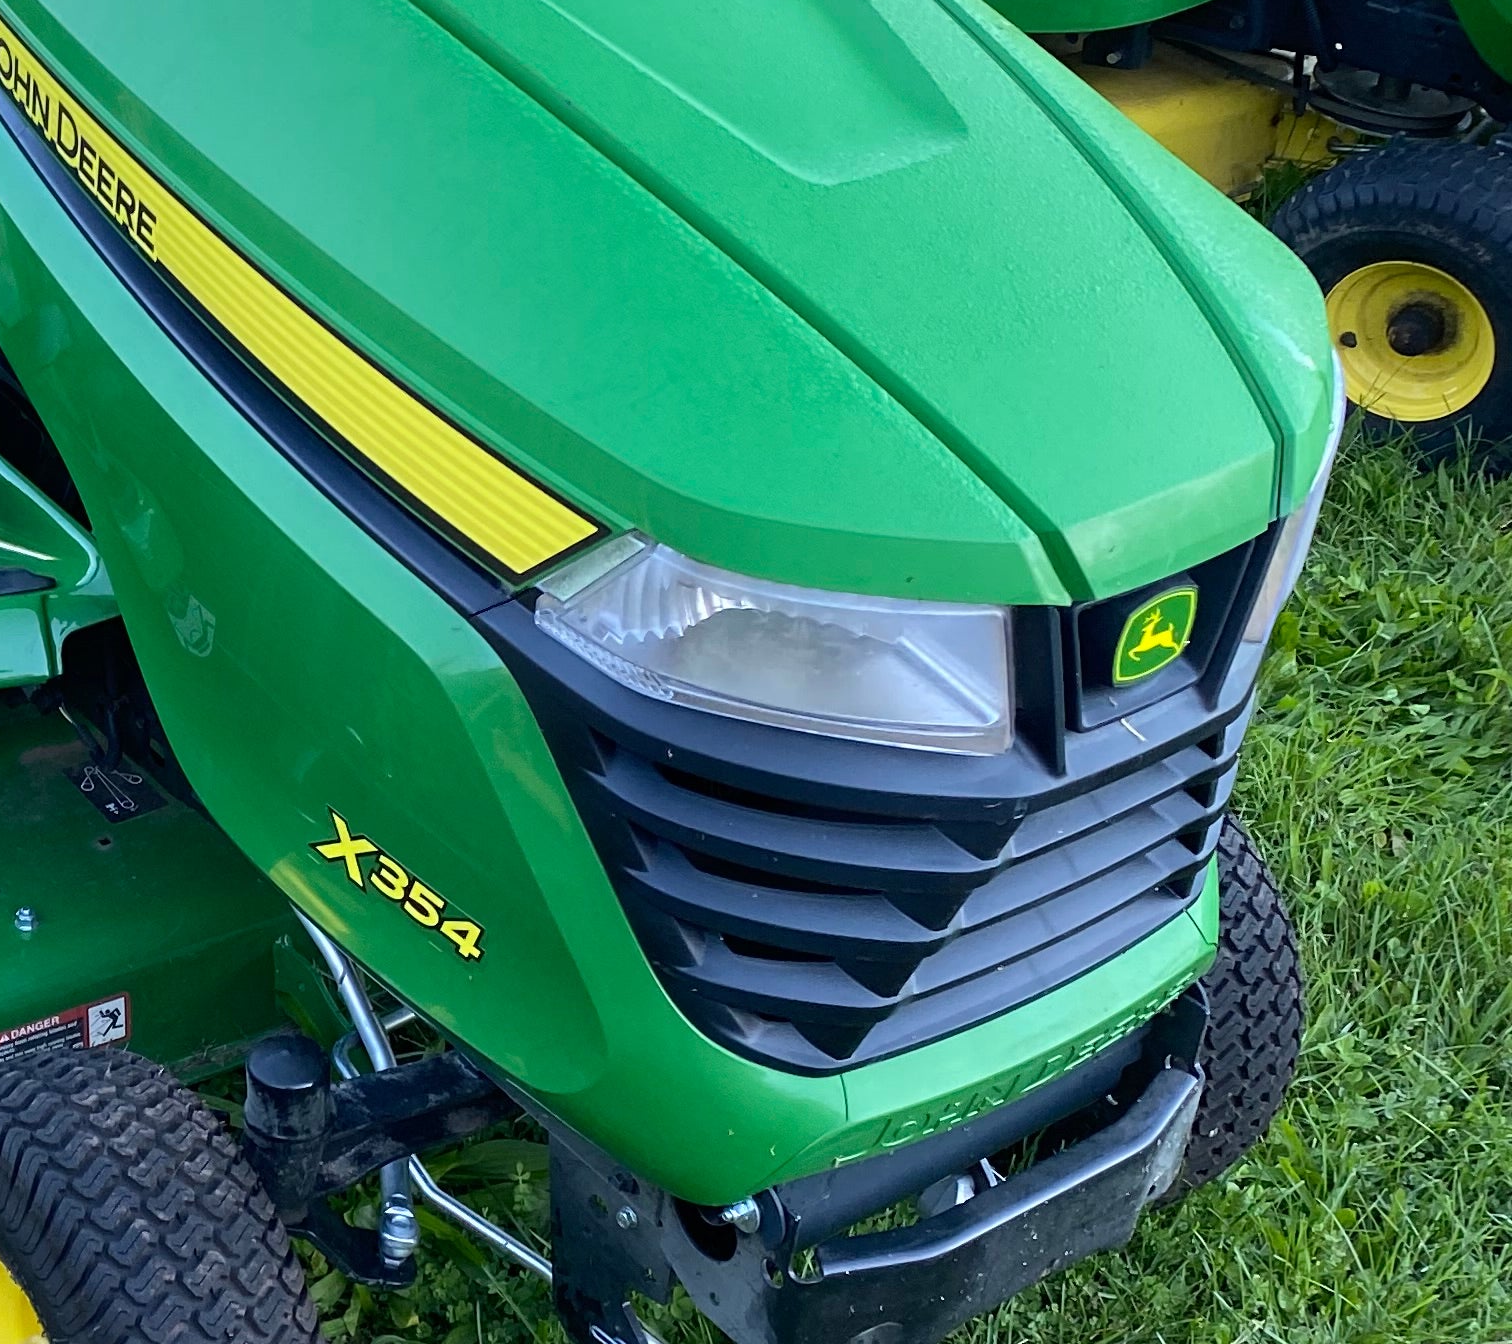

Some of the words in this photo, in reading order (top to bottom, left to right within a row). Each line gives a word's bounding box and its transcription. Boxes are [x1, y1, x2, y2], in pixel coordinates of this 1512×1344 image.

[57, 100, 157, 252] DEERE
[311, 807, 484, 961] X354
[10, 1015, 60, 1040] DANGER
[834, 1074, 1021, 1168] JOHN
